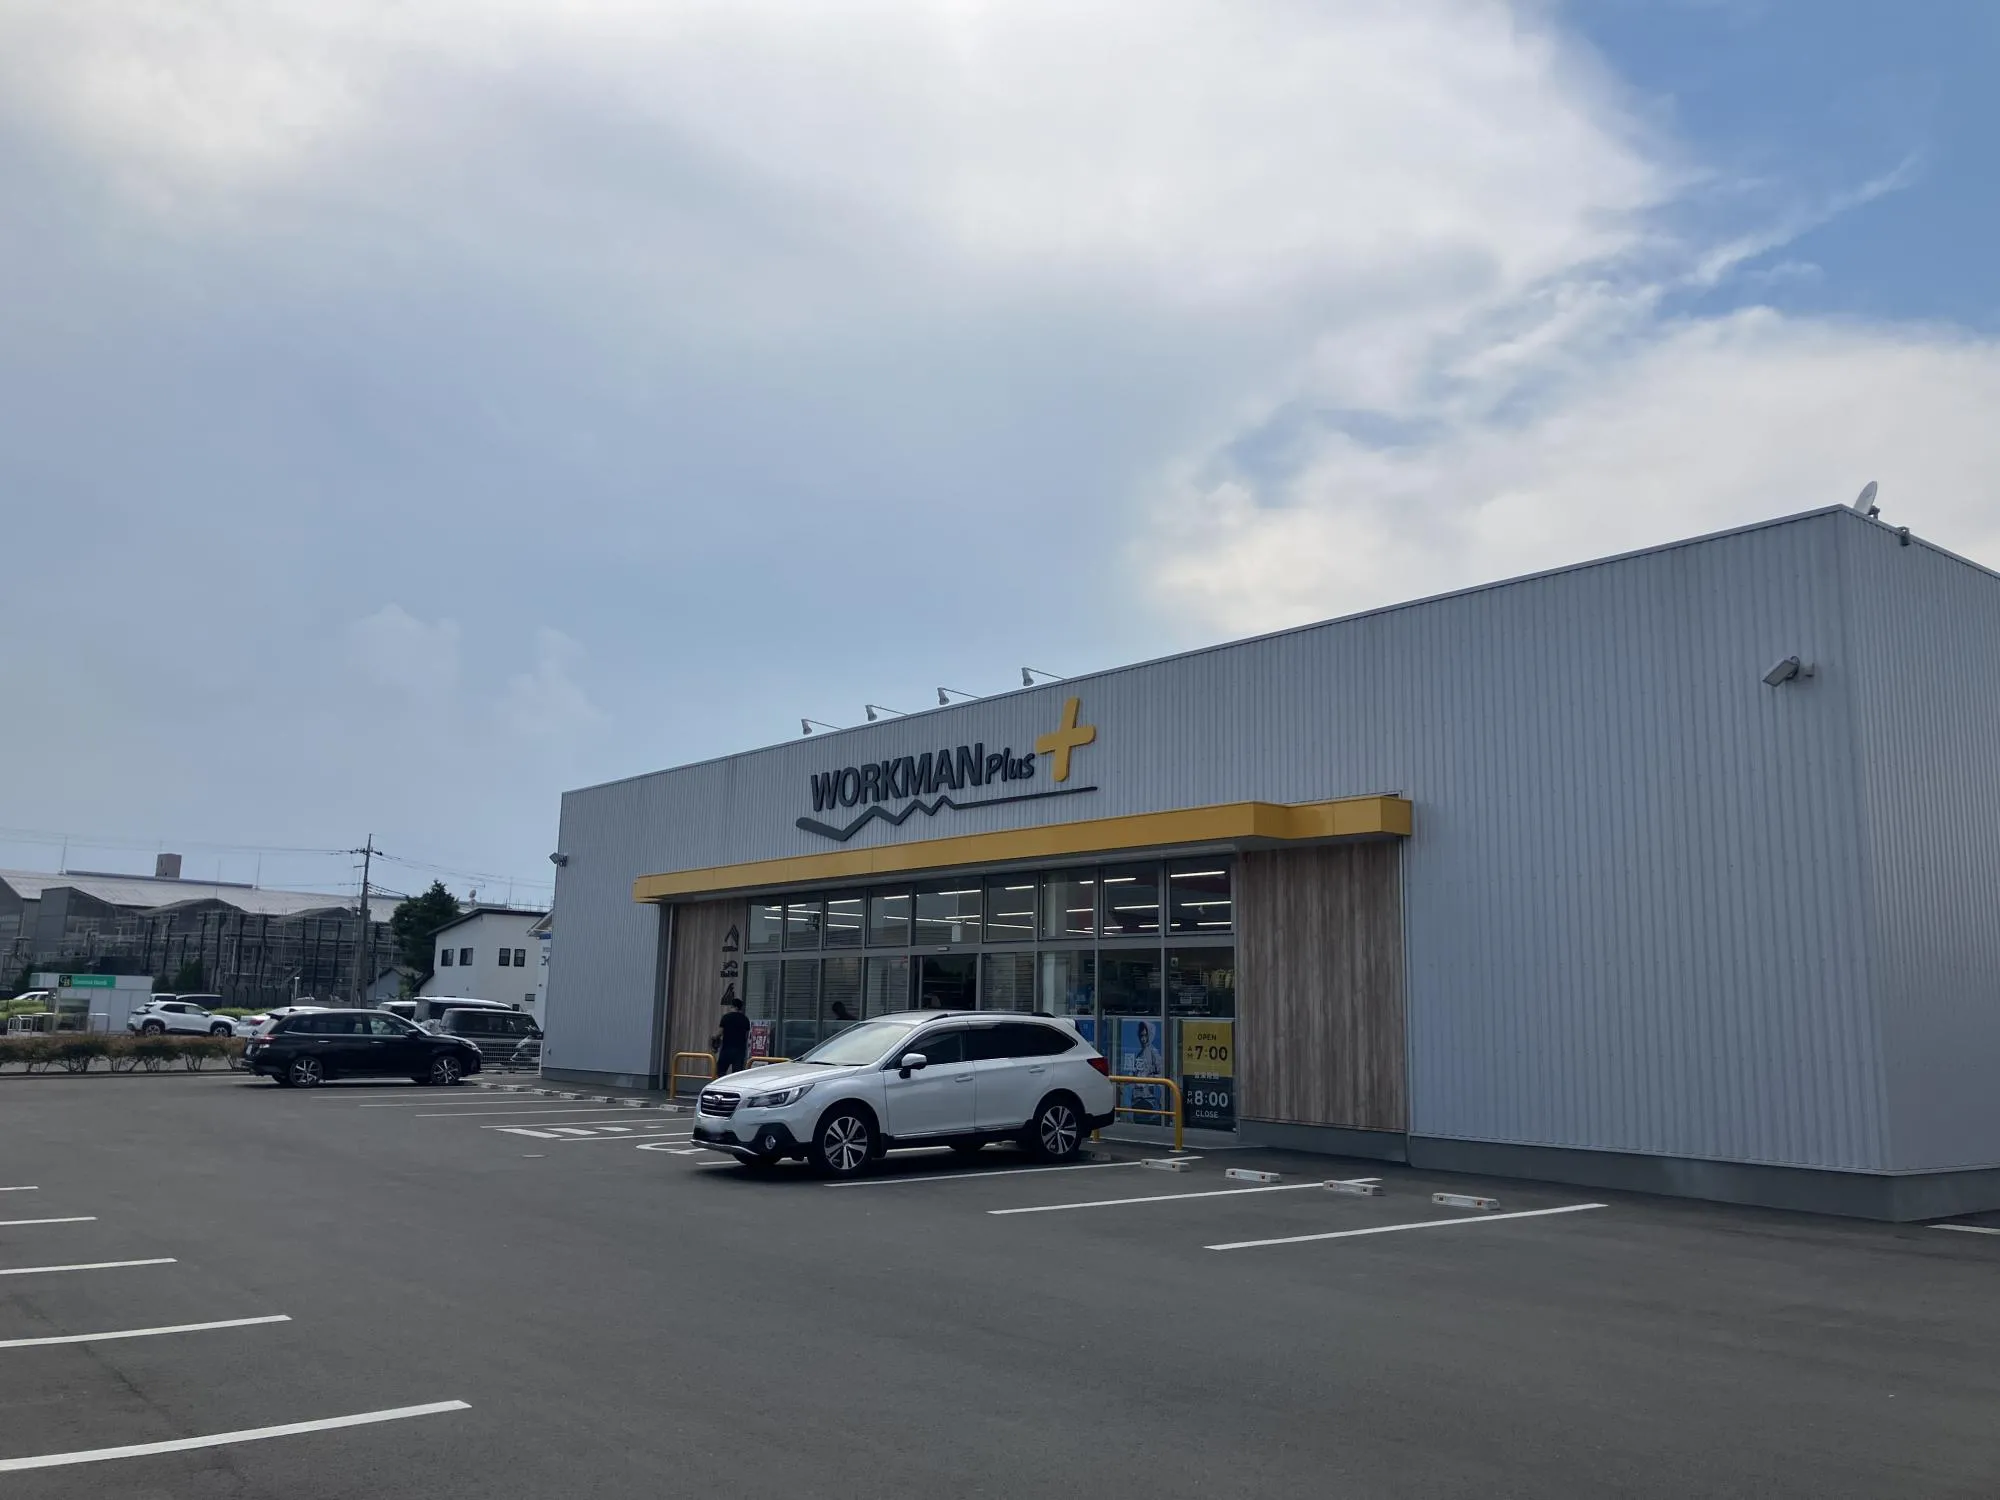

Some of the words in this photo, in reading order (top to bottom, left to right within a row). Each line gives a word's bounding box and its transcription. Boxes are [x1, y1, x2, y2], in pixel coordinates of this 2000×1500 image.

[810, 743, 983, 812] WORKMAN
[985, 747, 1035, 784] Plus
[1197, 1033, 1217, 1041] OPEN
[1195, 1045, 1228, 1062] 7:00
[1194, 1090, 1229, 1107] 8:00
[1195, 1109, 1219, 1119] CLOSE
